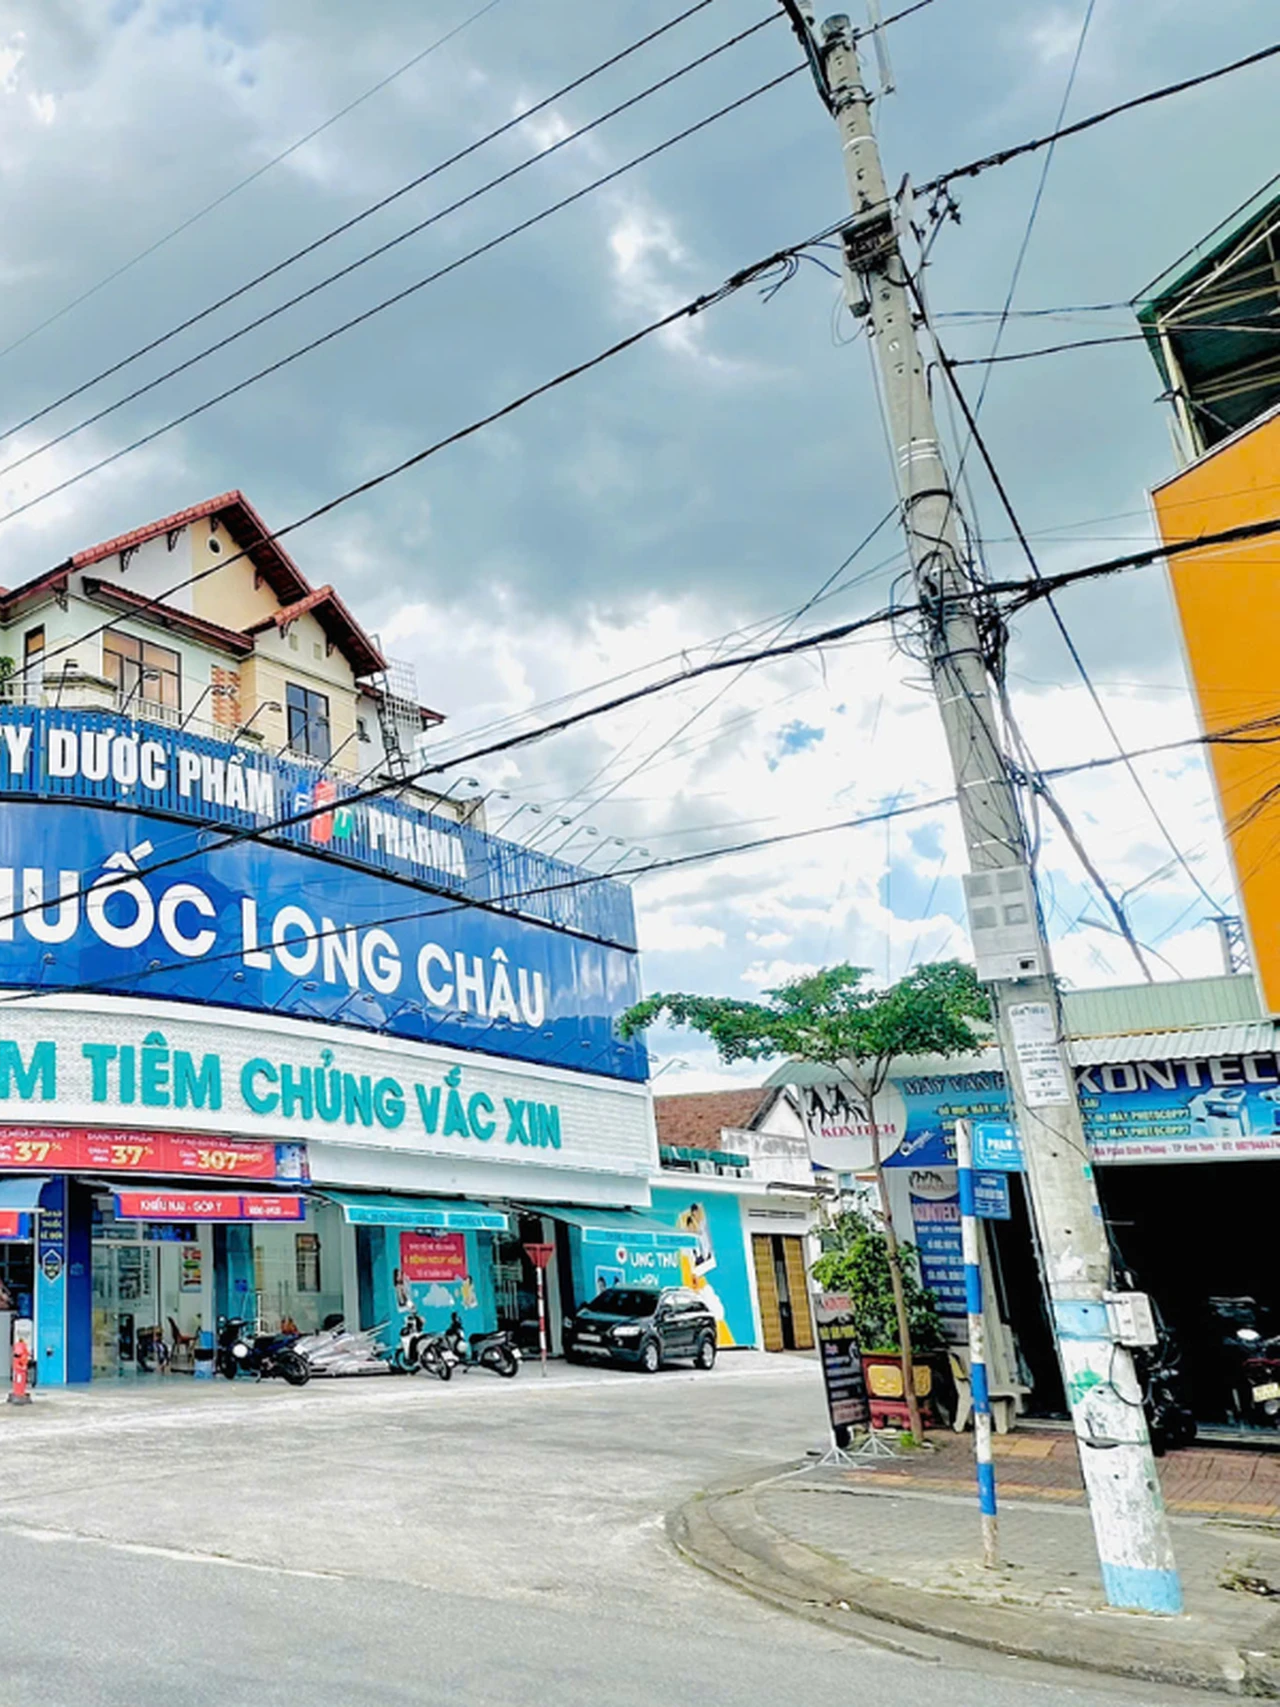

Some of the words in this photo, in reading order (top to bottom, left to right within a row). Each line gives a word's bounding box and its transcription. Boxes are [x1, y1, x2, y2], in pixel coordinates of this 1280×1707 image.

[48, 728, 167, 795] DƯỢC
[179, 752, 275, 821] PHẨM
[369, 805, 468, 879] PHARMA
[241, 896, 403, 995] LONG
[417, 946, 545, 1028] CHÂU
[82, 1030, 221, 1114] TIÊM
[240, 1048, 407, 1130] CHỦNG
[414, 1065, 497, 1142] VẮC
[503, 1097, 563, 1150] XIN
[1077, 1053, 1280, 1094] KONTEC
